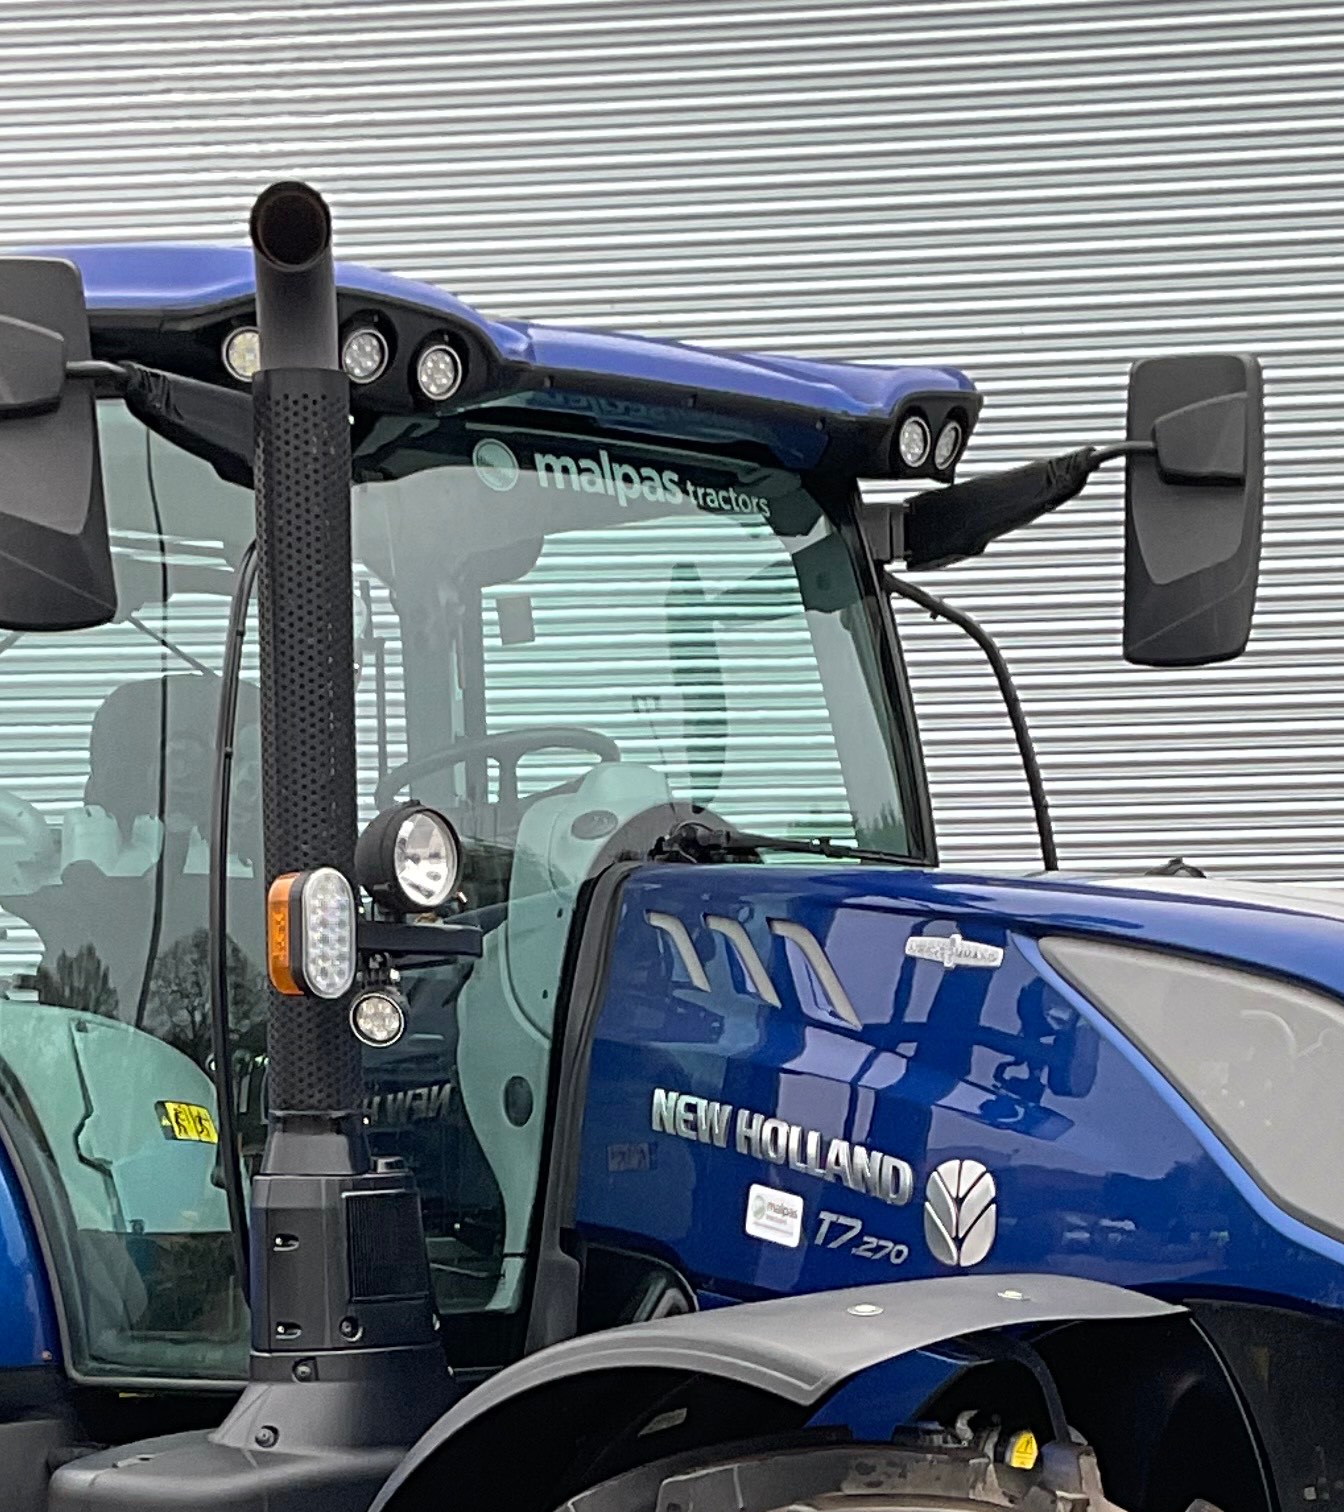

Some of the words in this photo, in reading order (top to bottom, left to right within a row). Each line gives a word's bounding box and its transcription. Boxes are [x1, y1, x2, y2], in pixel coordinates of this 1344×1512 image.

[534, 449, 684, 507] malpas
[685, 479, 771, 518] tractors
[652, 1088, 733, 1149] NEW
[735, 1108, 914, 1207] HOLLAND
